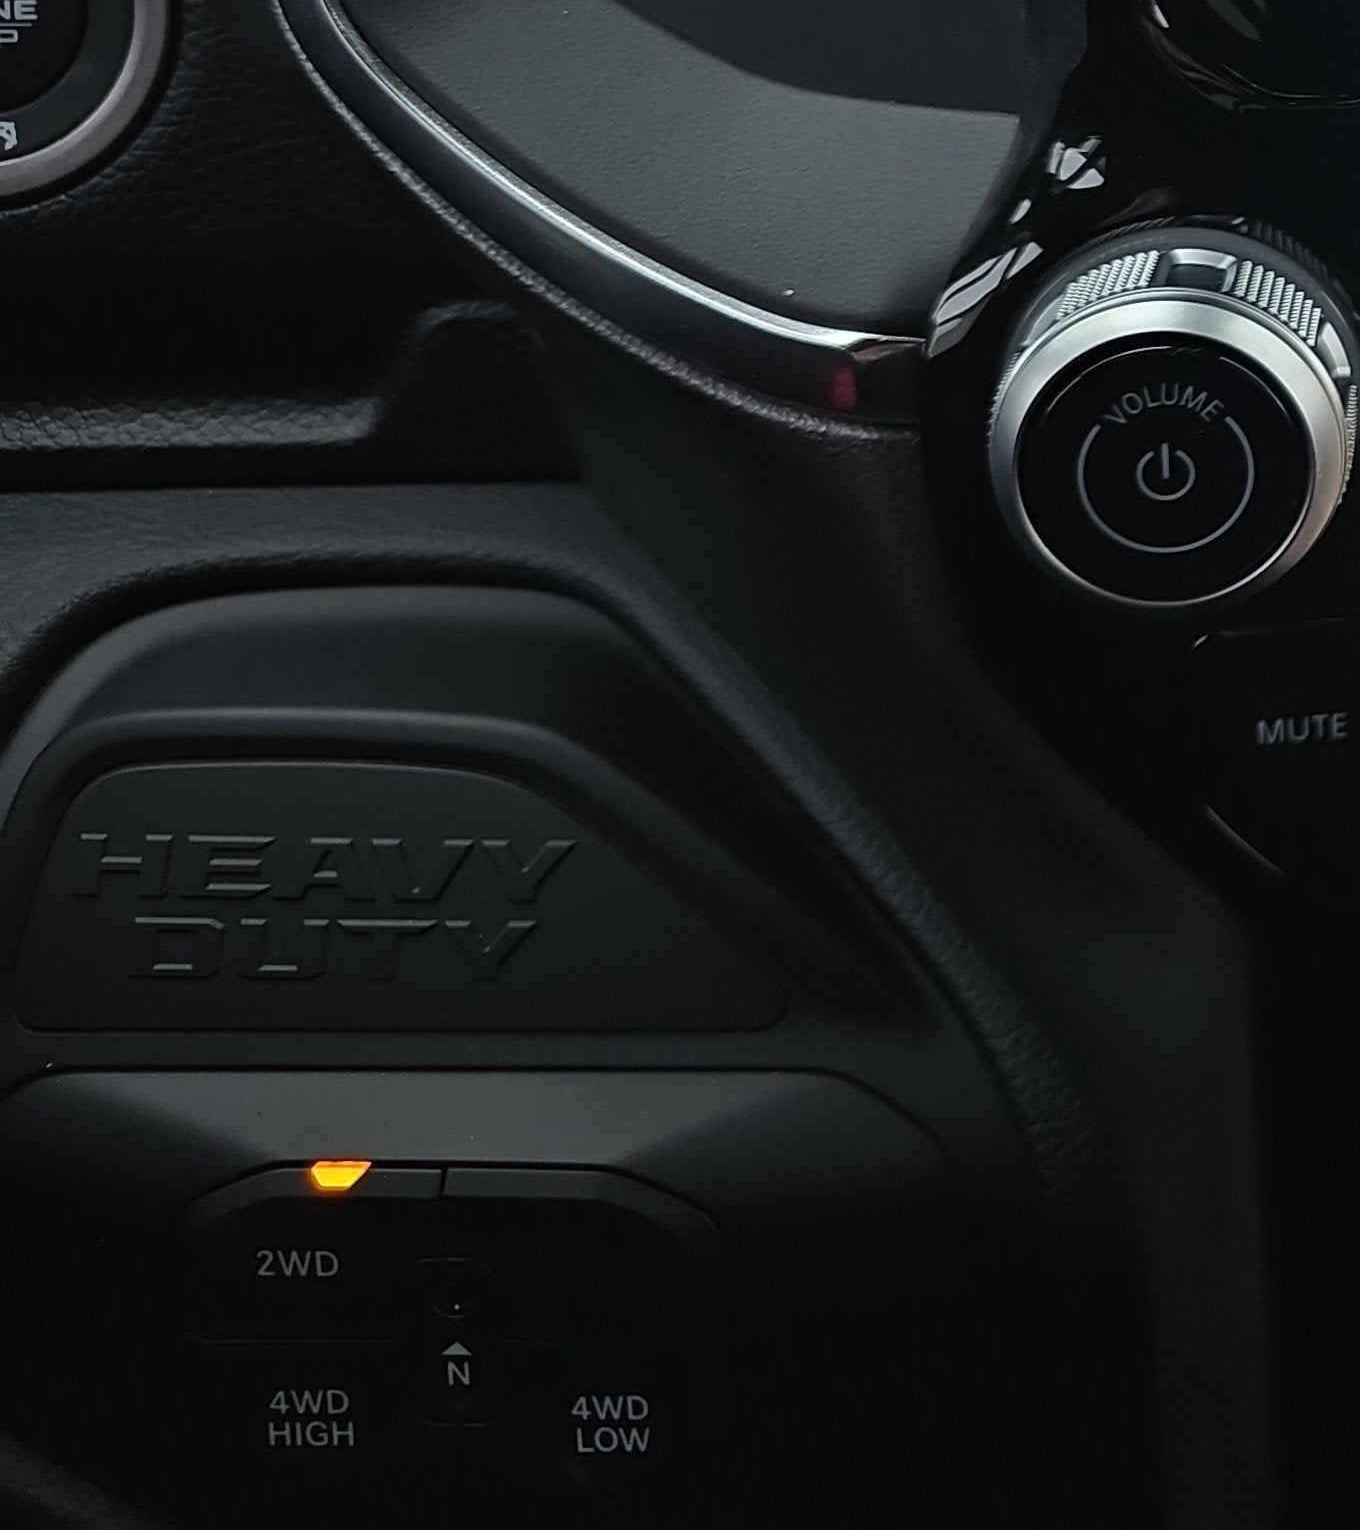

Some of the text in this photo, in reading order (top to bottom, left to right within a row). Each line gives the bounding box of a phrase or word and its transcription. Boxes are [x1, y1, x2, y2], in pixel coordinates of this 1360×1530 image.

[1101, 379, 1227, 429] VOLUME
[1254, 709, 1351, 747] MUTE
[70, 832, 579, 903] HEAVY
[126, 916, 540, 981] DUTY
[256, 1250, 340, 1278] 2WD
[446, 1363, 472, 1386] N
[269, 1389, 351, 1417] 4WD
[571, 1396, 650, 1422] 4WD
[267, 1421, 356, 1448] HIGH
[575, 1427, 652, 1454] LOW
